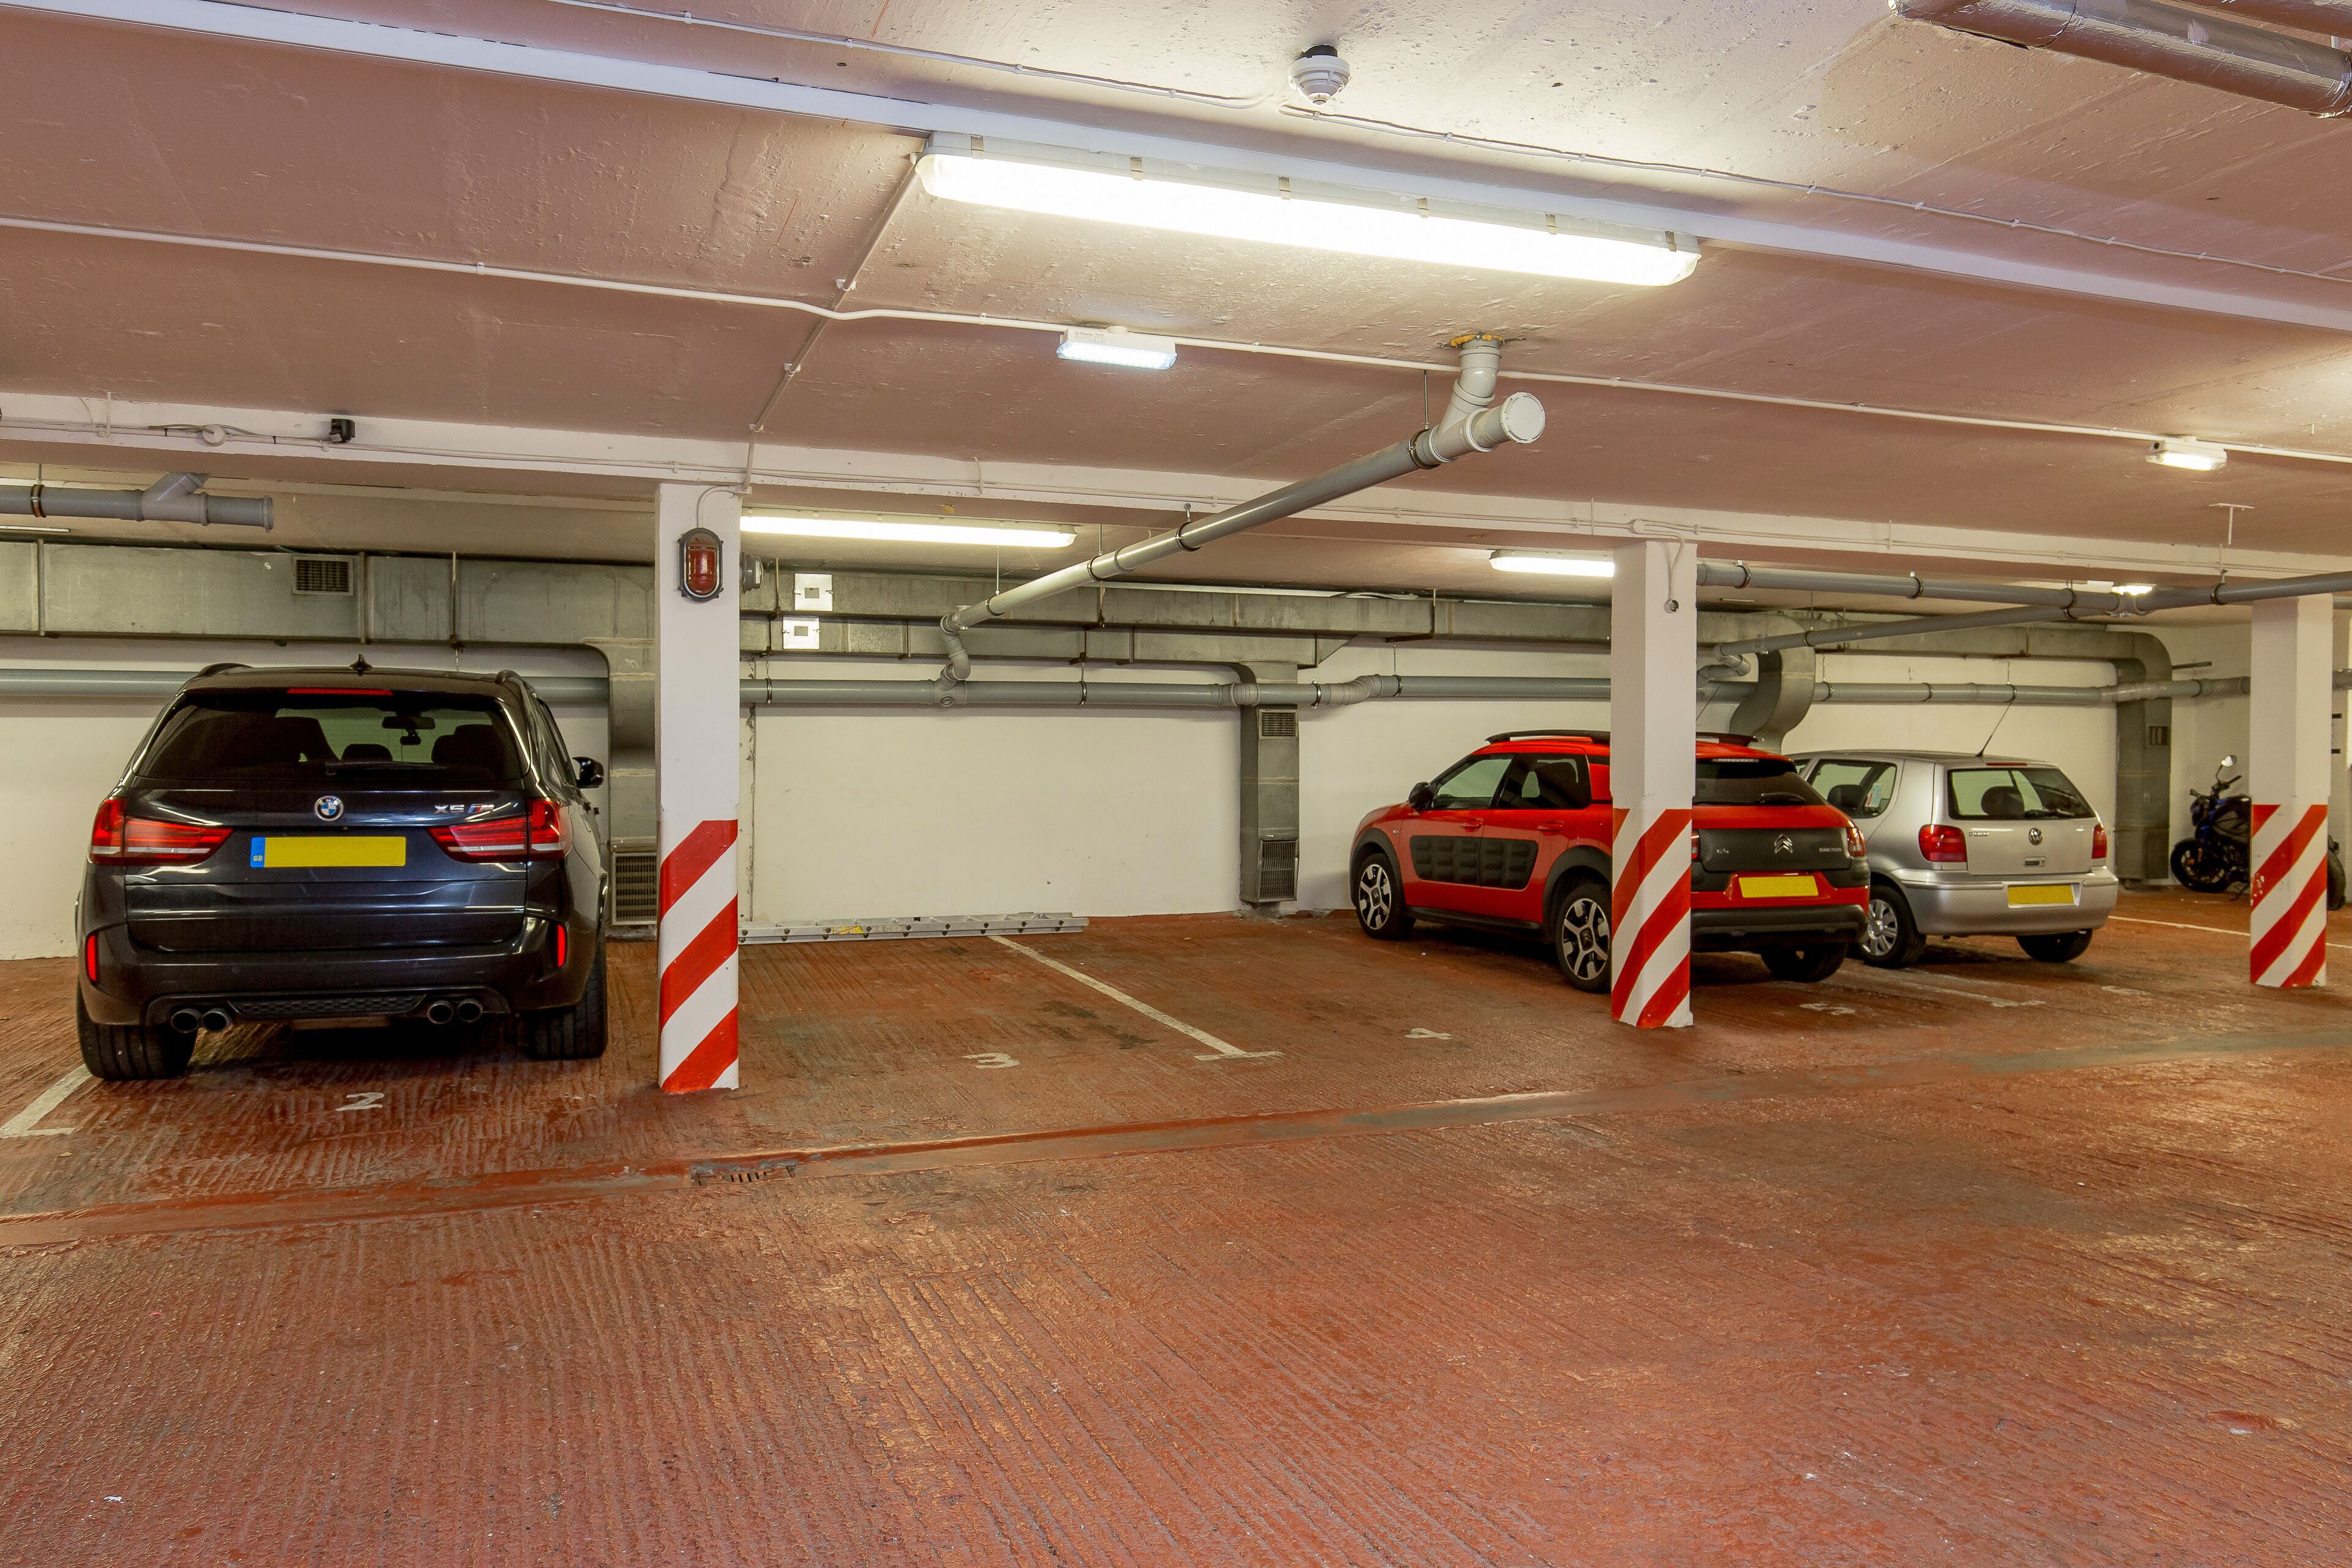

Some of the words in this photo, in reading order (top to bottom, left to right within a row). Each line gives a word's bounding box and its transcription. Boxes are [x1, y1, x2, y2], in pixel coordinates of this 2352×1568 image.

[434, 804, 464, 813] X5
[1405, 1028, 1451, 1040] 4
[962, 1053, 1020, 1069] 3
[335, 1092, 385, 1111] 2
